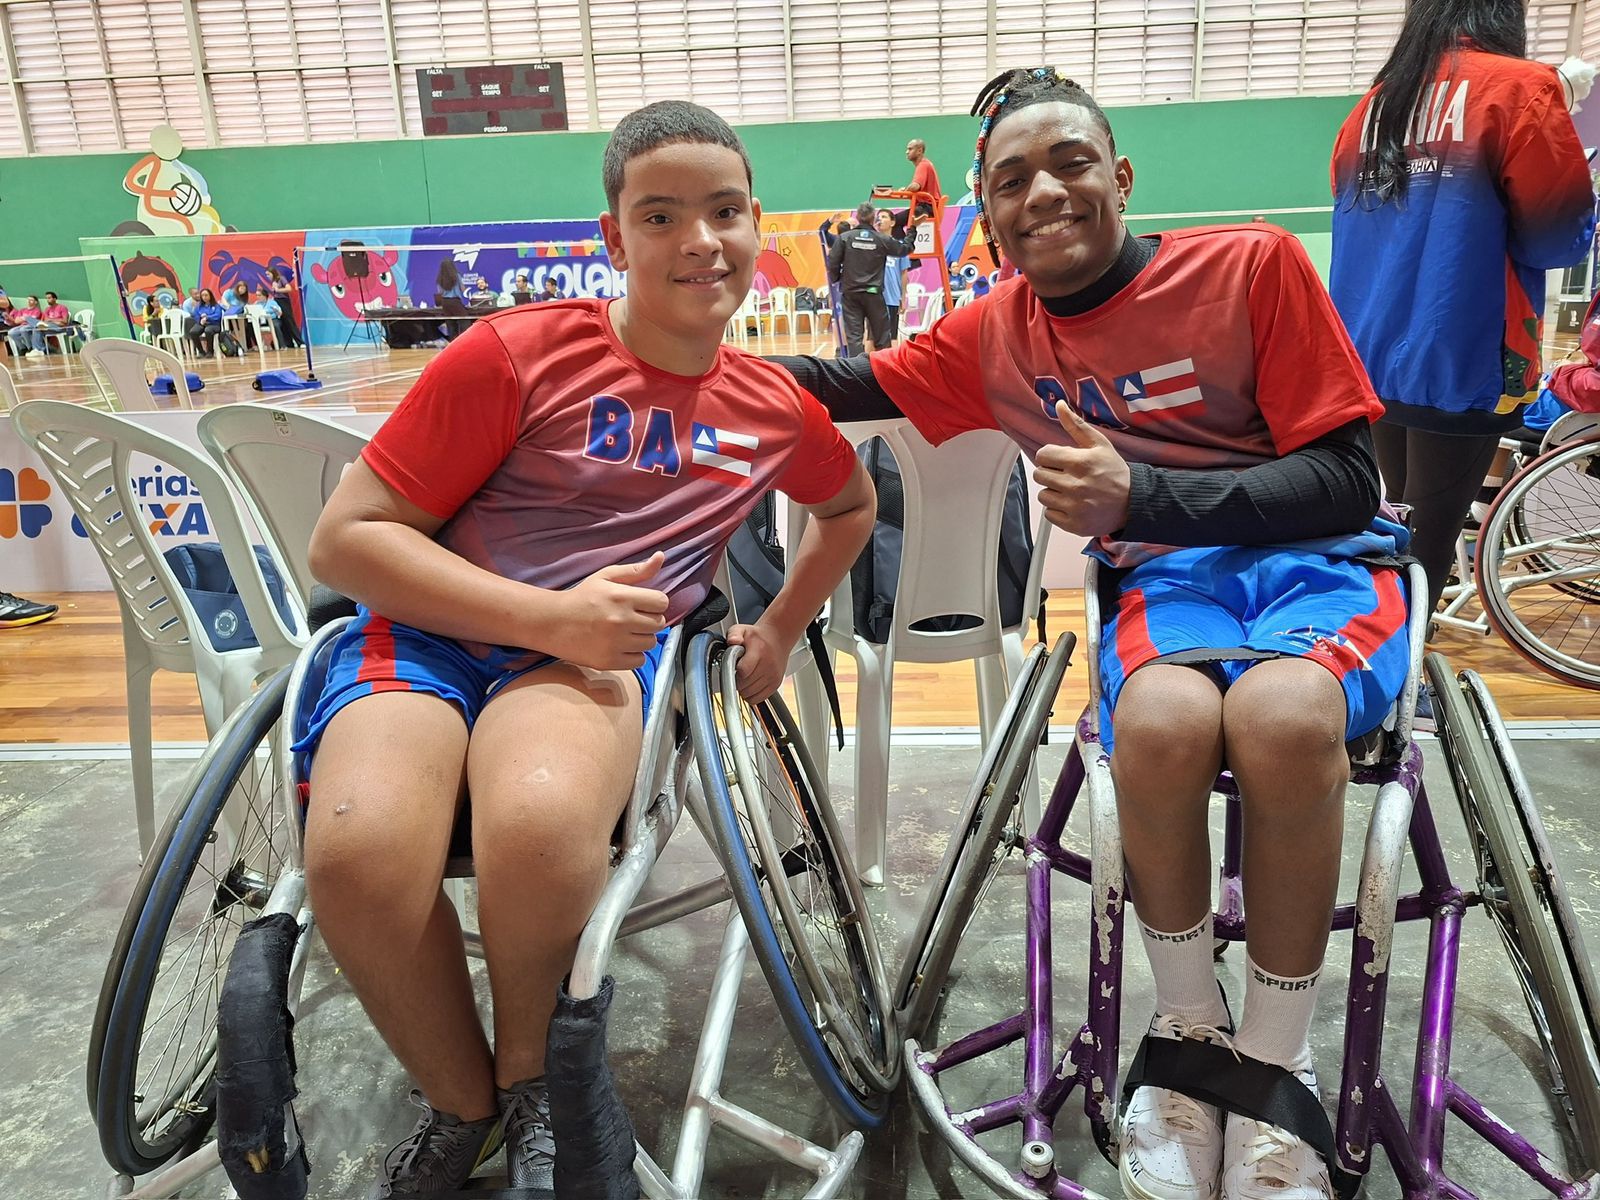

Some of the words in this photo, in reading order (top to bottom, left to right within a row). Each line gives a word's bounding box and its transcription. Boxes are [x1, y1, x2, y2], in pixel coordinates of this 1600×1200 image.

[917, 233, 930, 243] 02
[583, 394, 682, 478] BA
[1143, 923, 1207, 943] SPORT
[1253, 973, 1321, 992] SPORT
